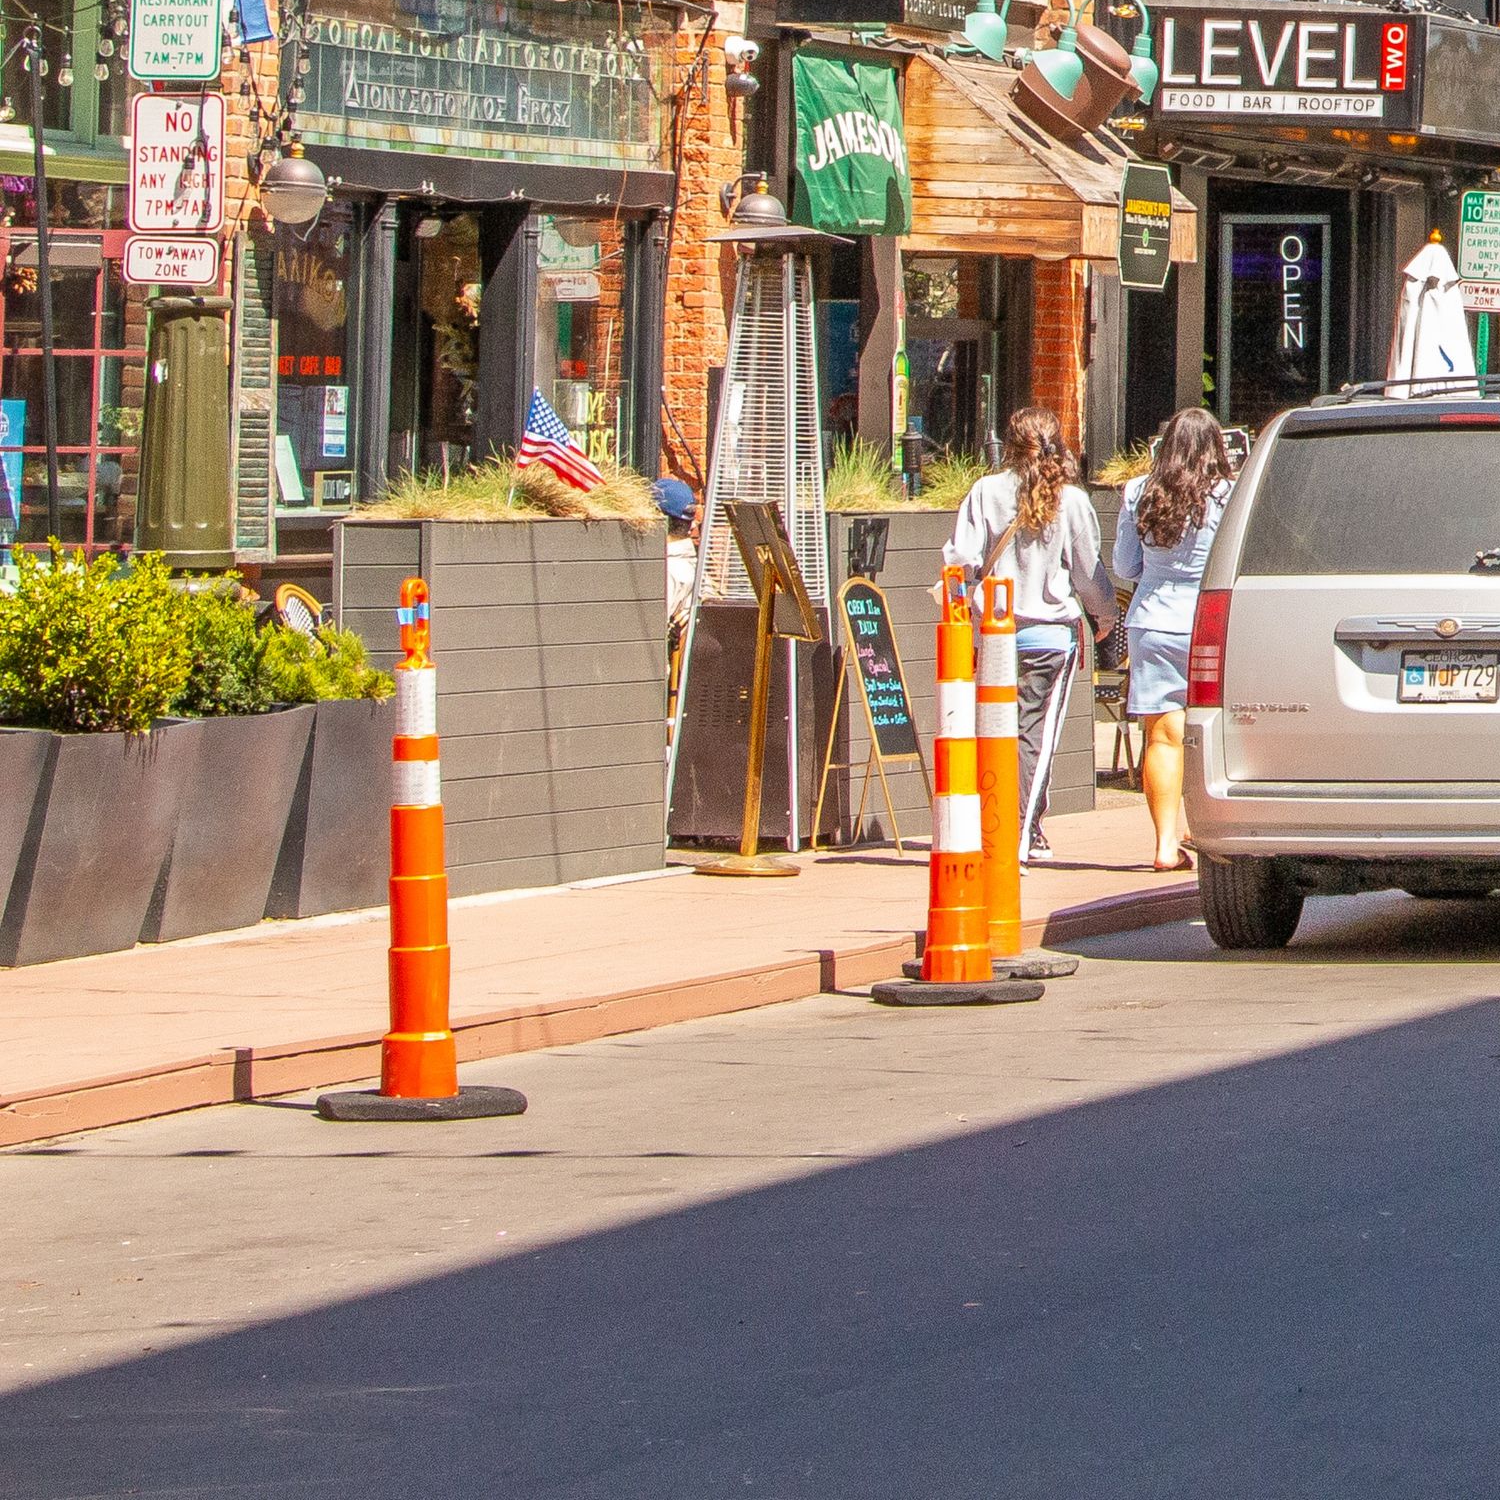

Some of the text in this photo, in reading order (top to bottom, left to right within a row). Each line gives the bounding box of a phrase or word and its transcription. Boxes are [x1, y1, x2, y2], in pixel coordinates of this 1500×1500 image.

[143, 13, 209, 27] CARRYOUT
[161, 32, 194, 46] ONLY
[145, 51, 204, 65] 7AM-7PM
[1161, 17, 1378, 90] LEVEL
[1385, 26, 1406, 88] TWO
[1168, 93, 1376, 113] FOOD BAR ROOFTOP
[165, 111, 193, 132] NO
[808, 111, 907, 176] JAMESON
[139, 145, 218, 163] STANDING
[139, 173, 167, 189] ANY
[1466, 196, 1483, 206] MAX
[1467, 206, 1483, 220] 10
[1478, 250, 1499, 261] ONLY
[154, 263, 188, 277] ZONE
[1280, 235, 1304, 349] OPEN
[1473, 297, 1495, 307] ZONE
